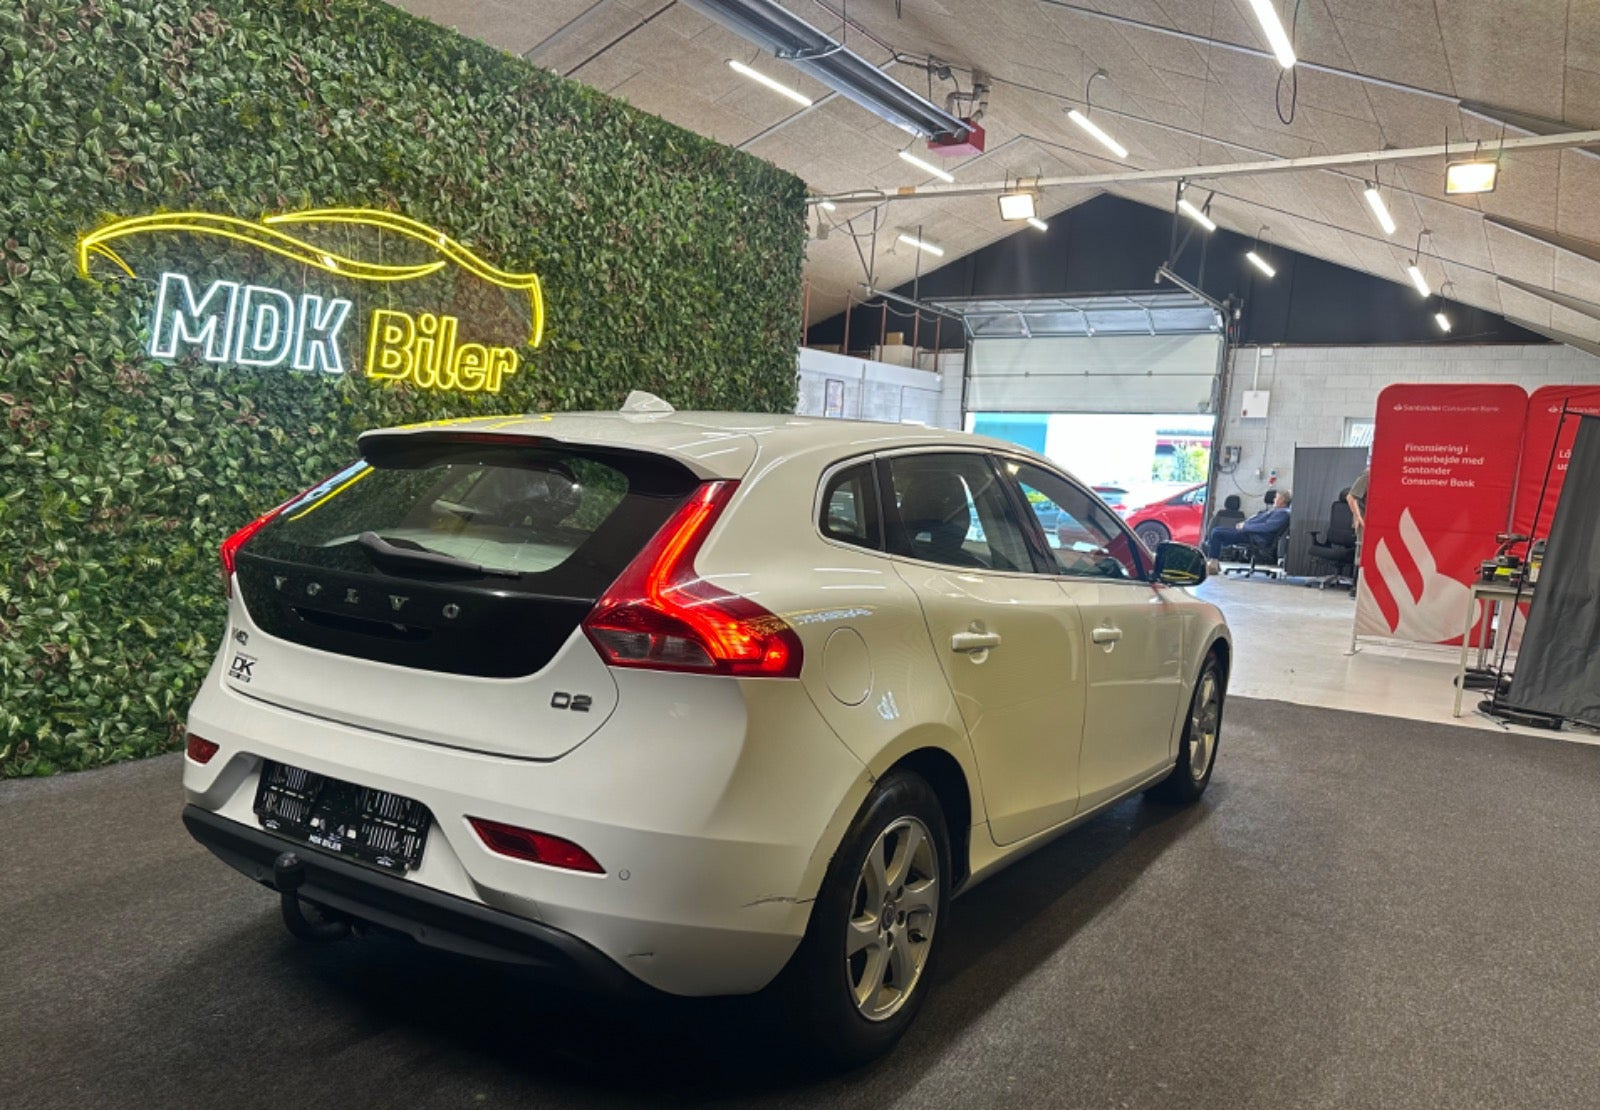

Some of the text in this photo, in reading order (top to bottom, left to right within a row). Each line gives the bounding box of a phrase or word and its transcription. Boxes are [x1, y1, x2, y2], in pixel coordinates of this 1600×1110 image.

[151, 272, 518, 393] MDK Biler
[1403, 404, 1441, 412] Santander
[1405, 444, 1463, 454] Finansiering
[1403, 455, 1484, 465] samarbejde med
[1403, 466, 1451, 475] Santander
[1402, 477, 1475, 487] Consumer Bank
[274, 575, 460, 619] VOLVO
[231, 656, 256, 676] DK
[551, 691, 592, 712] D2
